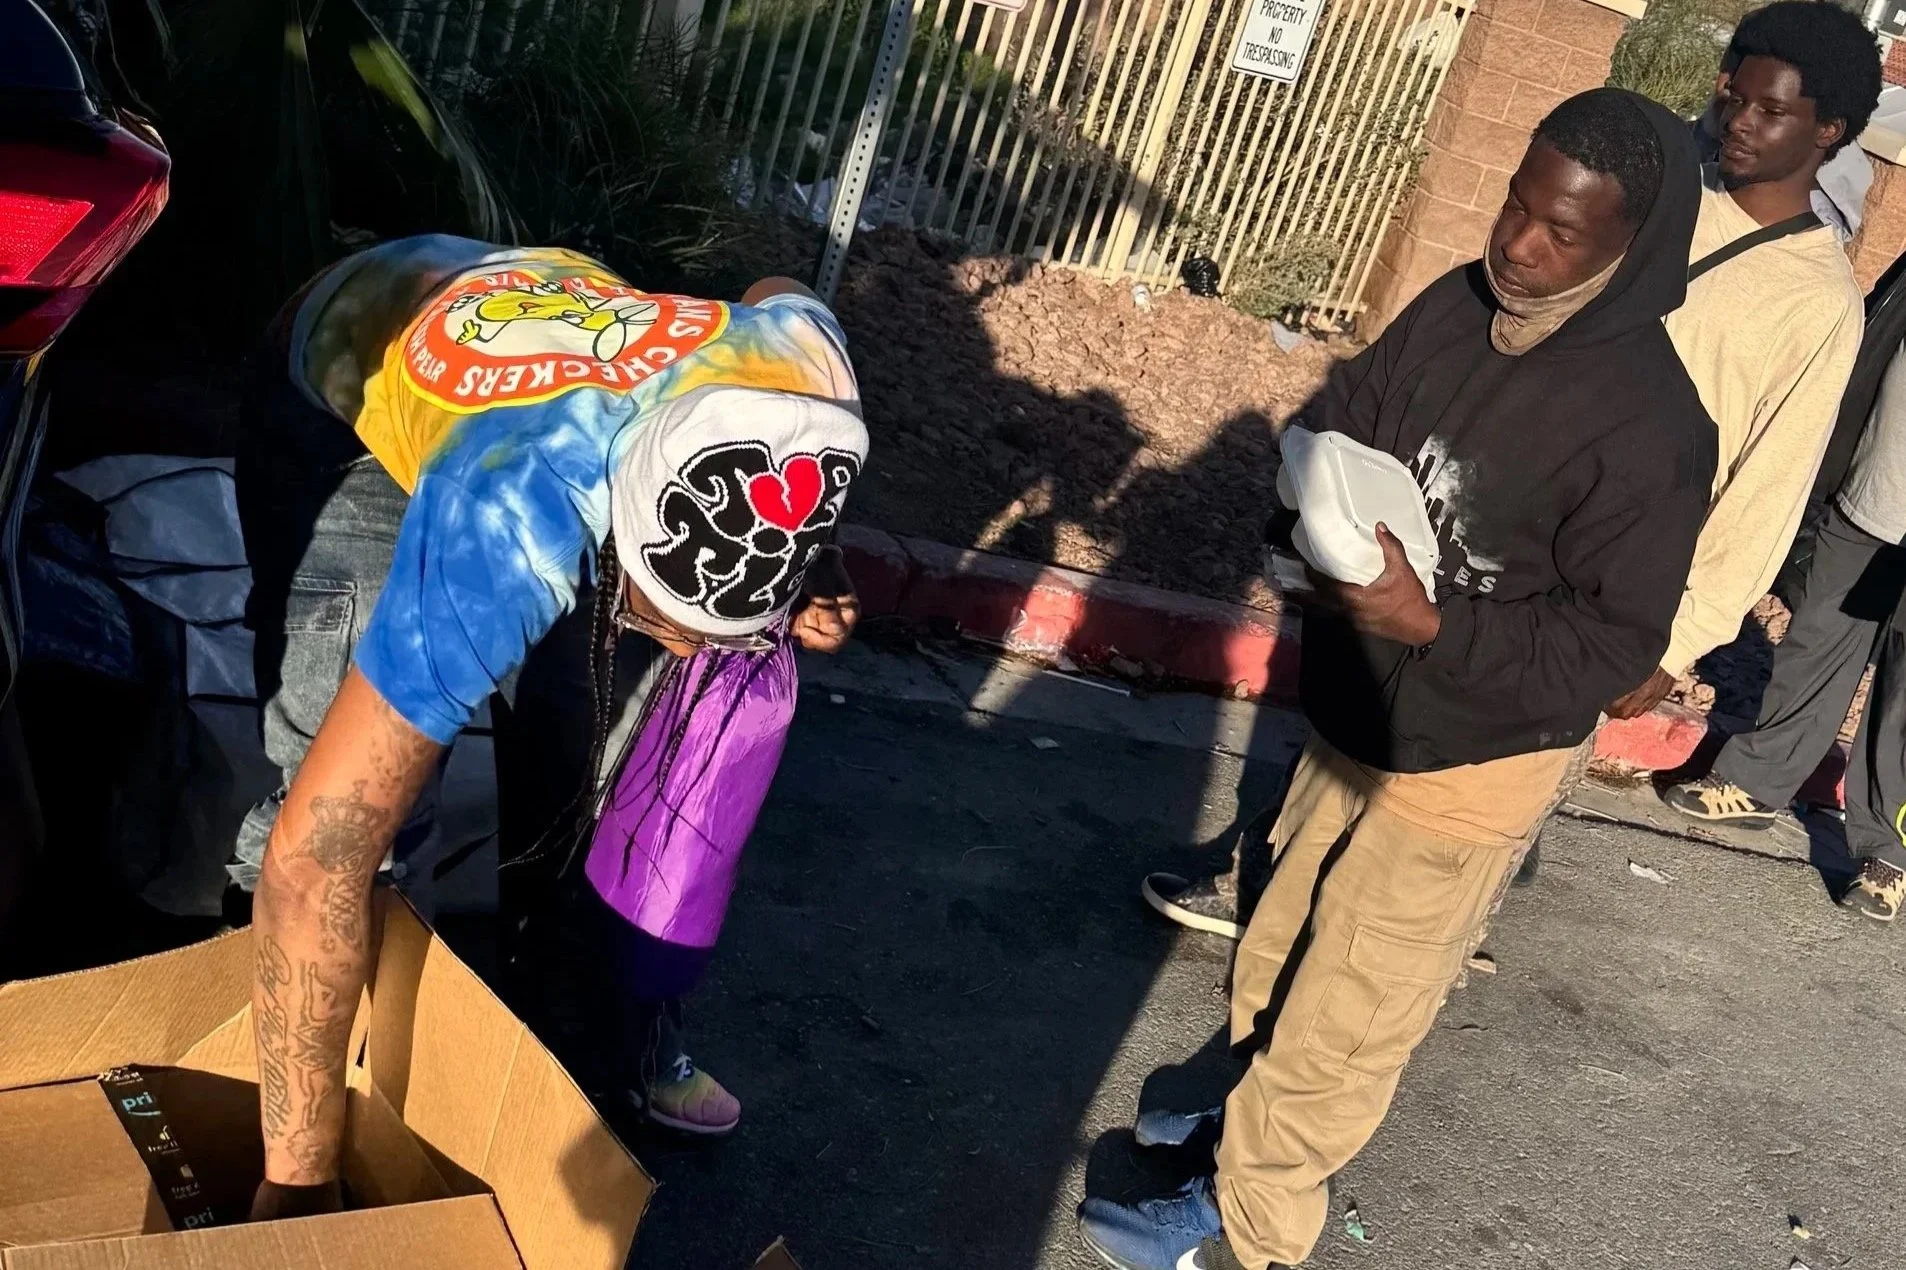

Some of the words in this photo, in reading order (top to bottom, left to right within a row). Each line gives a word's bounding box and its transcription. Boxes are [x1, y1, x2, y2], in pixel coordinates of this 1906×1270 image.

[1260, 0, 1307, 25] PROPERTY
[1268, 26, 1283, 44] NO
[1242, 42, 1295, 69] TRESPASSING
[453, 346, 678, 397] CHECKERS
